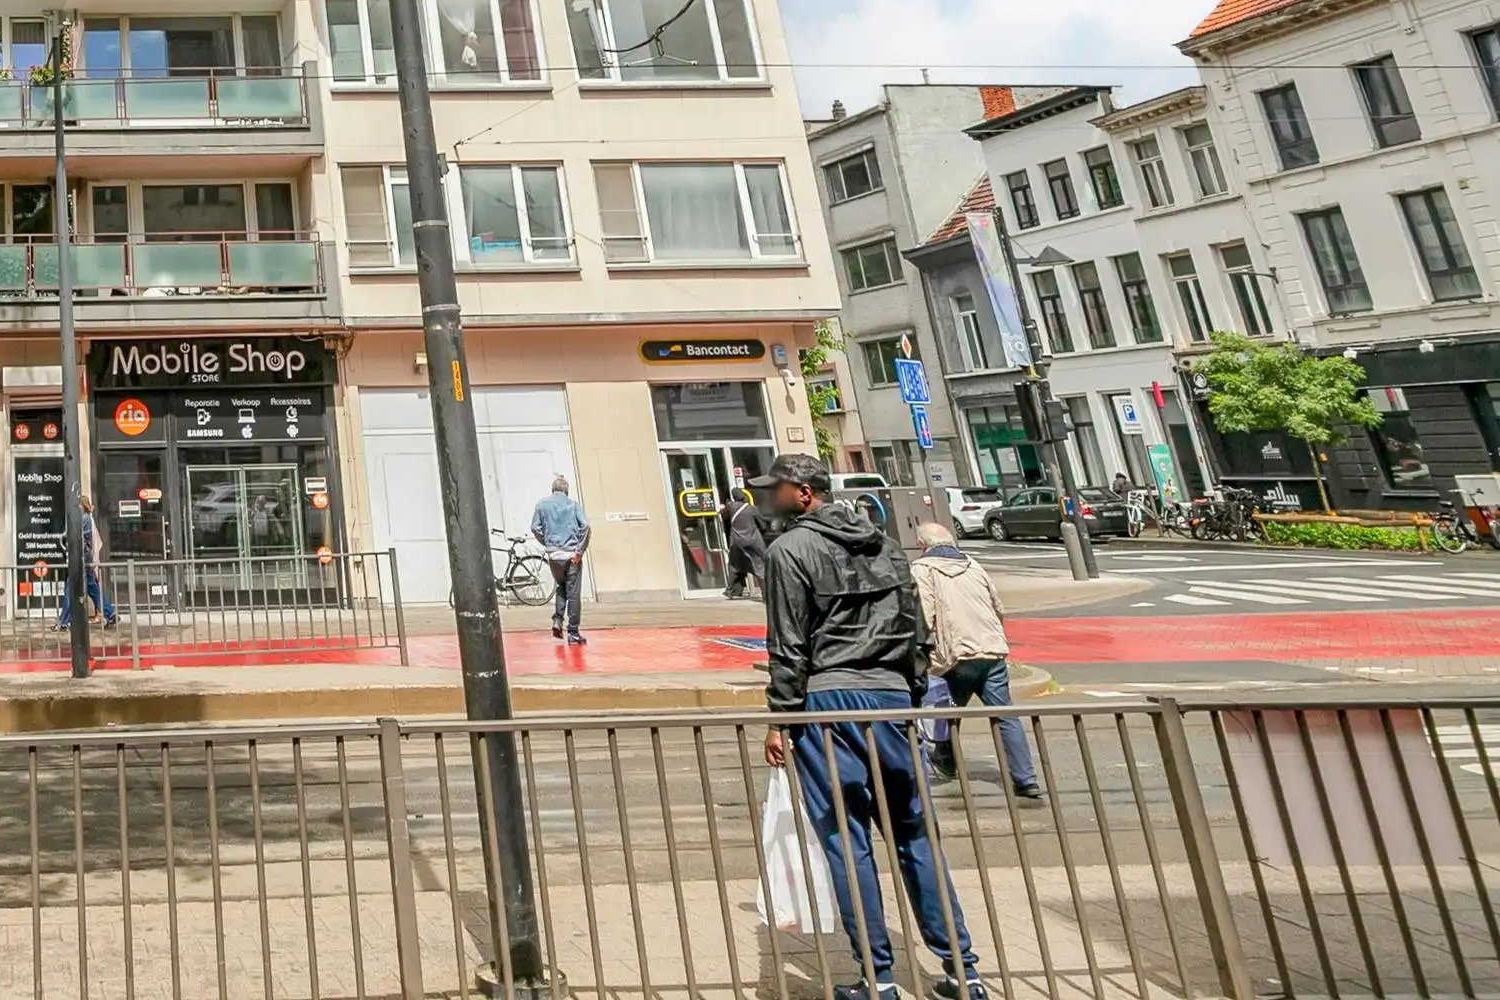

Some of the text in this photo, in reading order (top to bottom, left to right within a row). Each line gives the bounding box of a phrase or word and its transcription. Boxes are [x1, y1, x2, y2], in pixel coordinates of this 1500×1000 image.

[686, 345, 750, 356] Bancontact
[112, 343, 305, 380] Mobile Shop
[192, 374, 219, 383] STORE
[232, 398, 261, 407] Verkoop
[119, 405, 145, 422] ria
[187, 429, 224, 437] SAMSUNG
